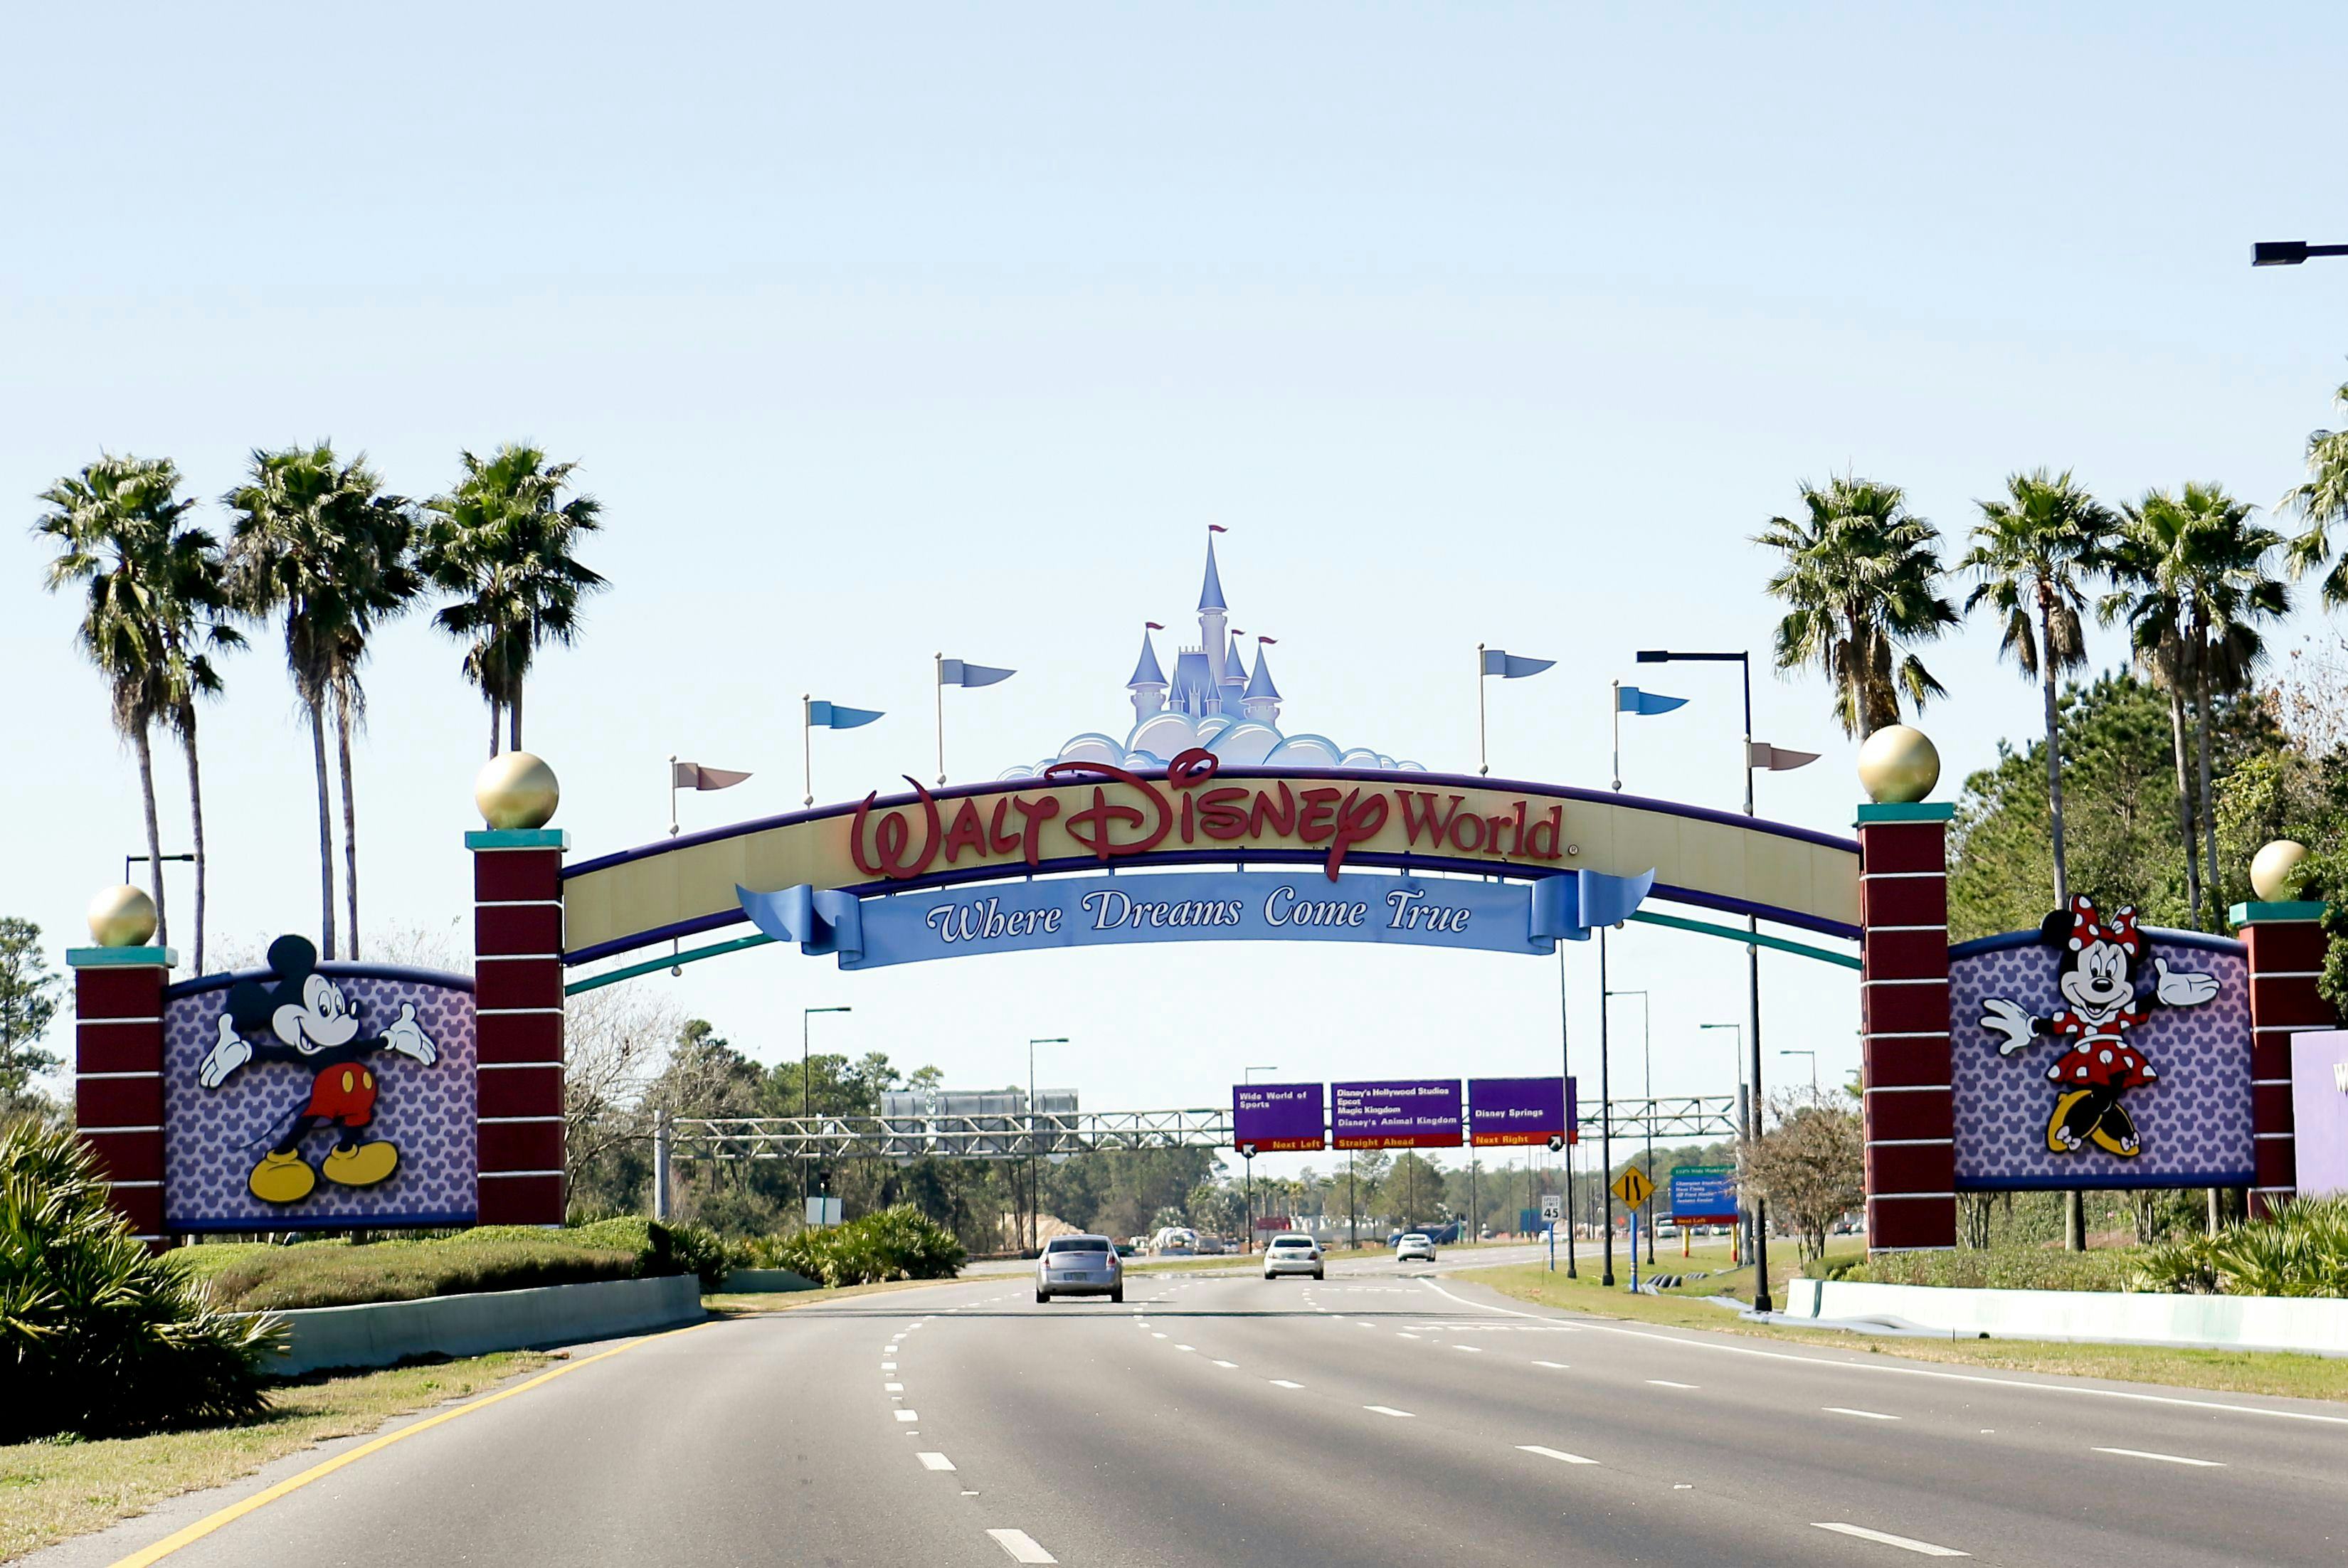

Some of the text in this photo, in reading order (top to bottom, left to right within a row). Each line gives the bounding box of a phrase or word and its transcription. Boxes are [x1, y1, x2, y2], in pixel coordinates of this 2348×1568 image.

[1394, 790, 1562, 859] World
[926, 886, 1471, 943] Where Dreams Come True
[1239, 1091, 1307, 1101] Wide World of
[1336, 1088, 1371, 1098] Disney's
[1372, 1088, 1416, 1097] Hollywood
[1239, 1101, 1270, 1110] Sports
[1337, 1098, 1362, 1106] Epcot
[1337, 1106, 1401, 1115] Magic Kingdom
[1475, 1108, 1543, 1118] Disney Springs
[1338, 1116, 1457, 1127] Disney's Animal Kingdom
[1272, 1140, 1321, 1149] Next Left
[1338, 1138, 1414, 1148] Straight Ahead
[1476, 1135, 1528, 1144] Next Right
[1543, 1208, 1559, 1218] 45
